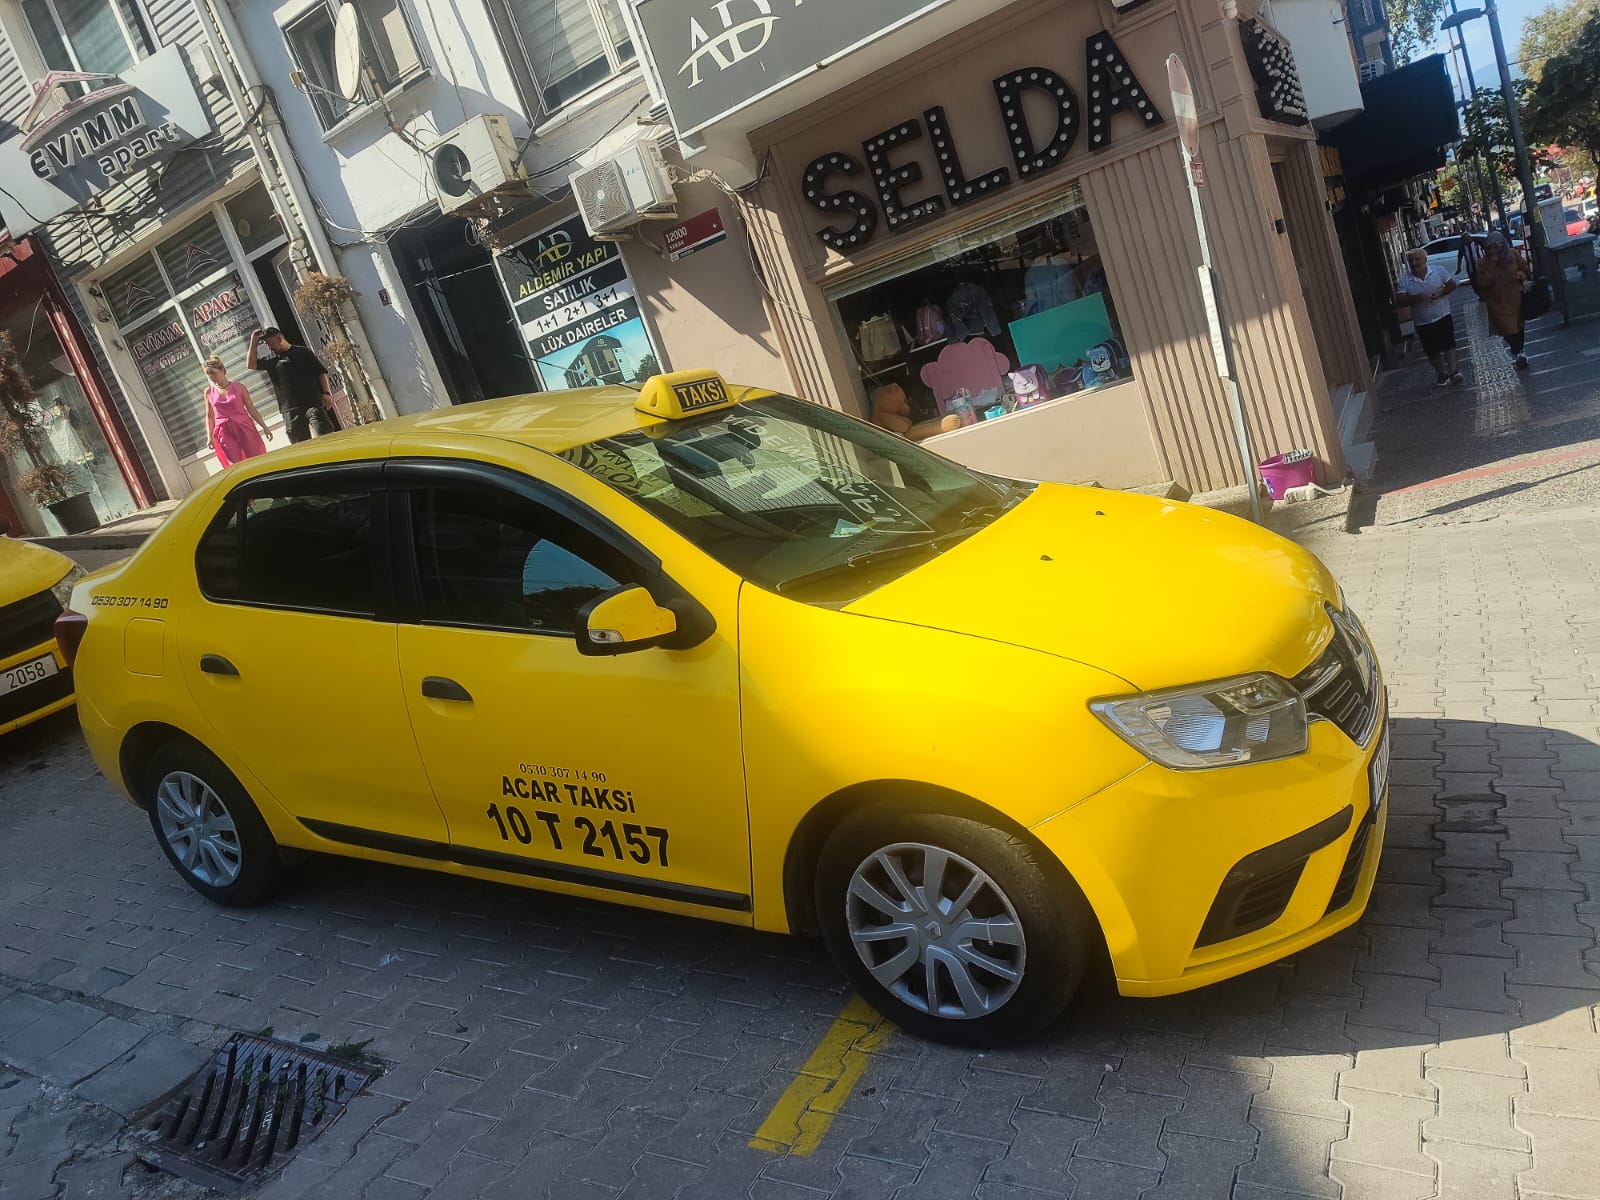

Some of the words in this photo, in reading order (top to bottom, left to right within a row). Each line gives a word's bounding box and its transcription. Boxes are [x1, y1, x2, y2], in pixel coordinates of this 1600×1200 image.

[98, 122, 180, 177] apart
[802, 29, 1164, 253] SELDA
[665, 226, 687, 243] 12000
[576, 244, 608, 270] YAPI
[193, 286, 242, 328] APART
[543, 275, 598, 310] SATILIK
[536, 313, 559, 334] 1+1
[564, 300, 588, 321] 2+1
[593, 286, 618, 309] 3+1
[541, 332, 566, 354] LÜX
[91, 595, 116, 606] 0530
[116, 596, 138, 607] 307
[139, 597, 152, 608] 14
[153, 598, 169, 609] 90
[6, 661, 46, 690] 2058
[519, 763, 547, 776] 0530
[550, 766, 570, 778] 307
[575, 769, 588, 781] 14
[591, 771, 606, 783] 90
[502, 775, 561, 804] ACAR
[486, 802, 532, 845] 10
[535, 810, 563, 850] T
[574, 816, 669, 868] 2157
